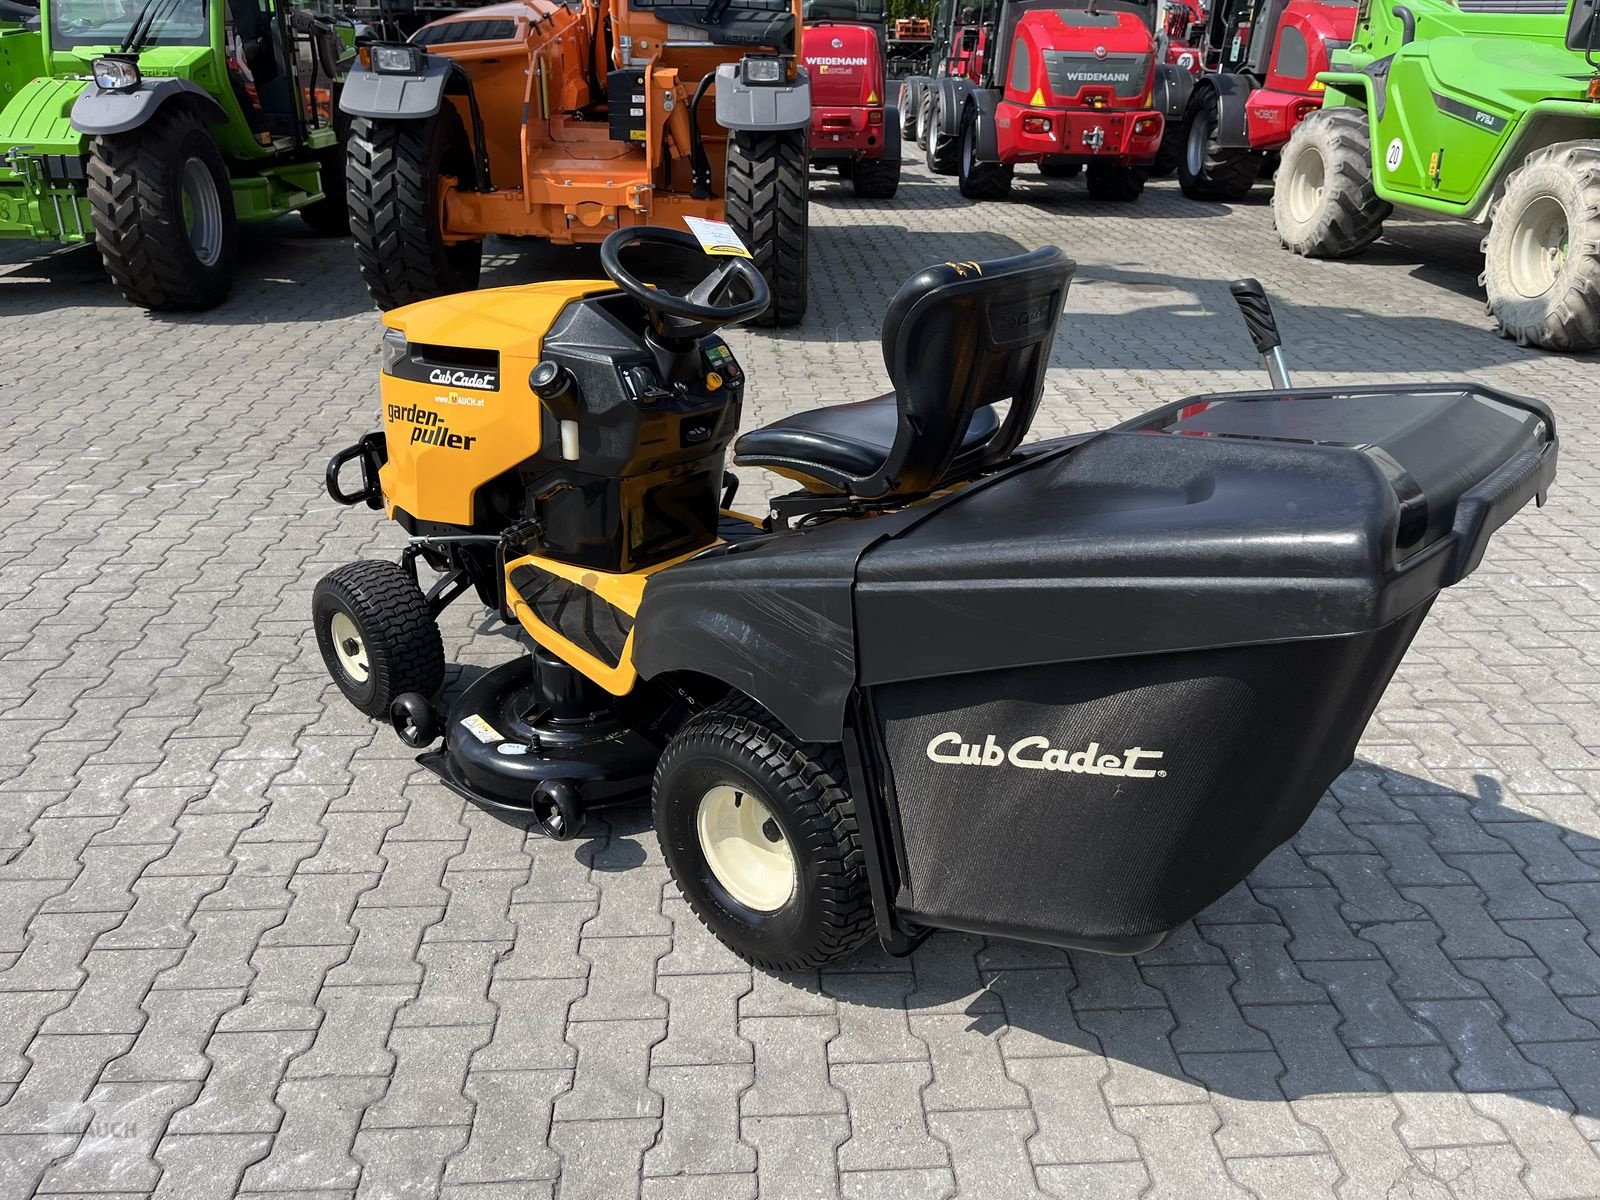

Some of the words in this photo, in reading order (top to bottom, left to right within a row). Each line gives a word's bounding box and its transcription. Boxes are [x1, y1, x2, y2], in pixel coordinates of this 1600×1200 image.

[805, 56, 868, 65] WEIDEMANN
[1066, 72, 1130, 82] WEIDEMANN
[1388, 144, 1400, 165] 20
[429, 369, 451, 385] Cub
[452, 371, 495, 389] Cadet
[388, 403, 445, 427] garden-
[410, 426, 477, 450] puller
[926, 731, 1005, 767] Cub
[1007, 735, 1164, 778] Cadet
